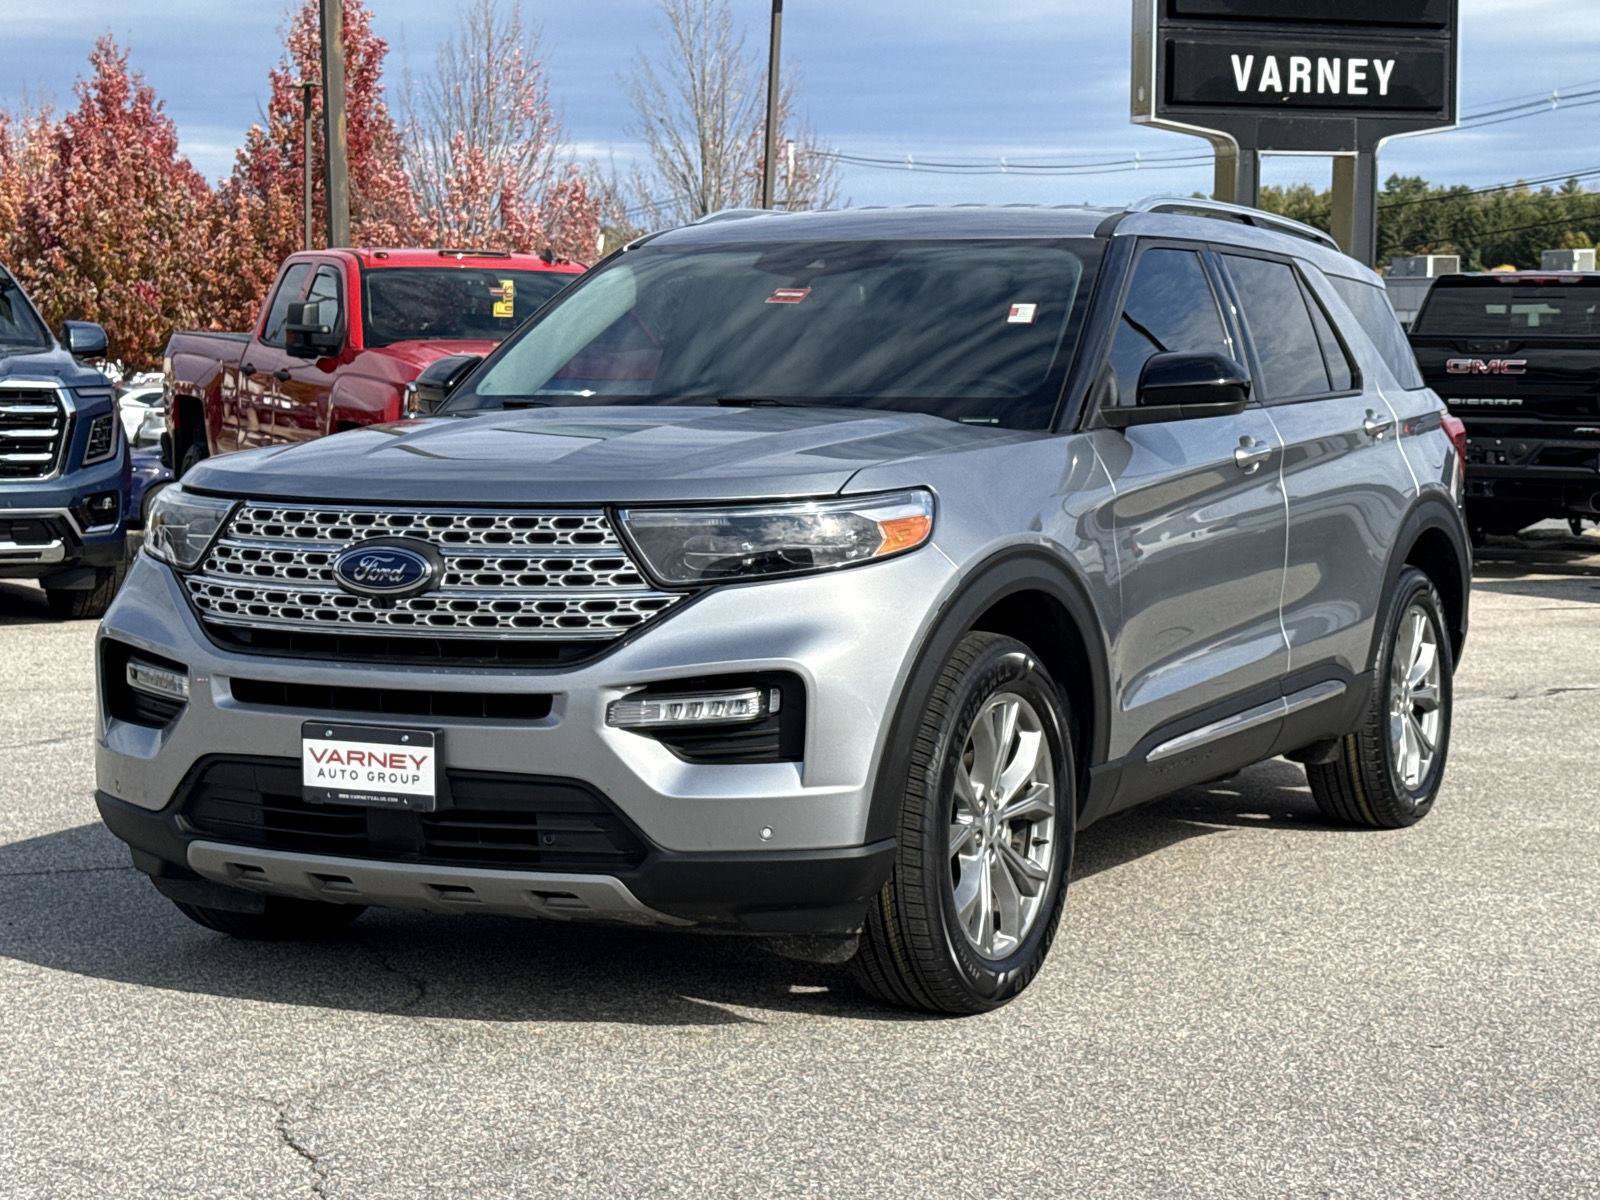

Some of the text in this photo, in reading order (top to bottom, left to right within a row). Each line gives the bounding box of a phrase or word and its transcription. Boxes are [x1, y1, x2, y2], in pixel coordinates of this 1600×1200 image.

[1231, 54, 1395, 95] VARNEY
[1446, 358, 1527, 374] GMC
[353, 555, 407, 582] Ford
[308, 747, 428, 771] VARNEY
[317, 767, 420, 785] AUTO GROUP
